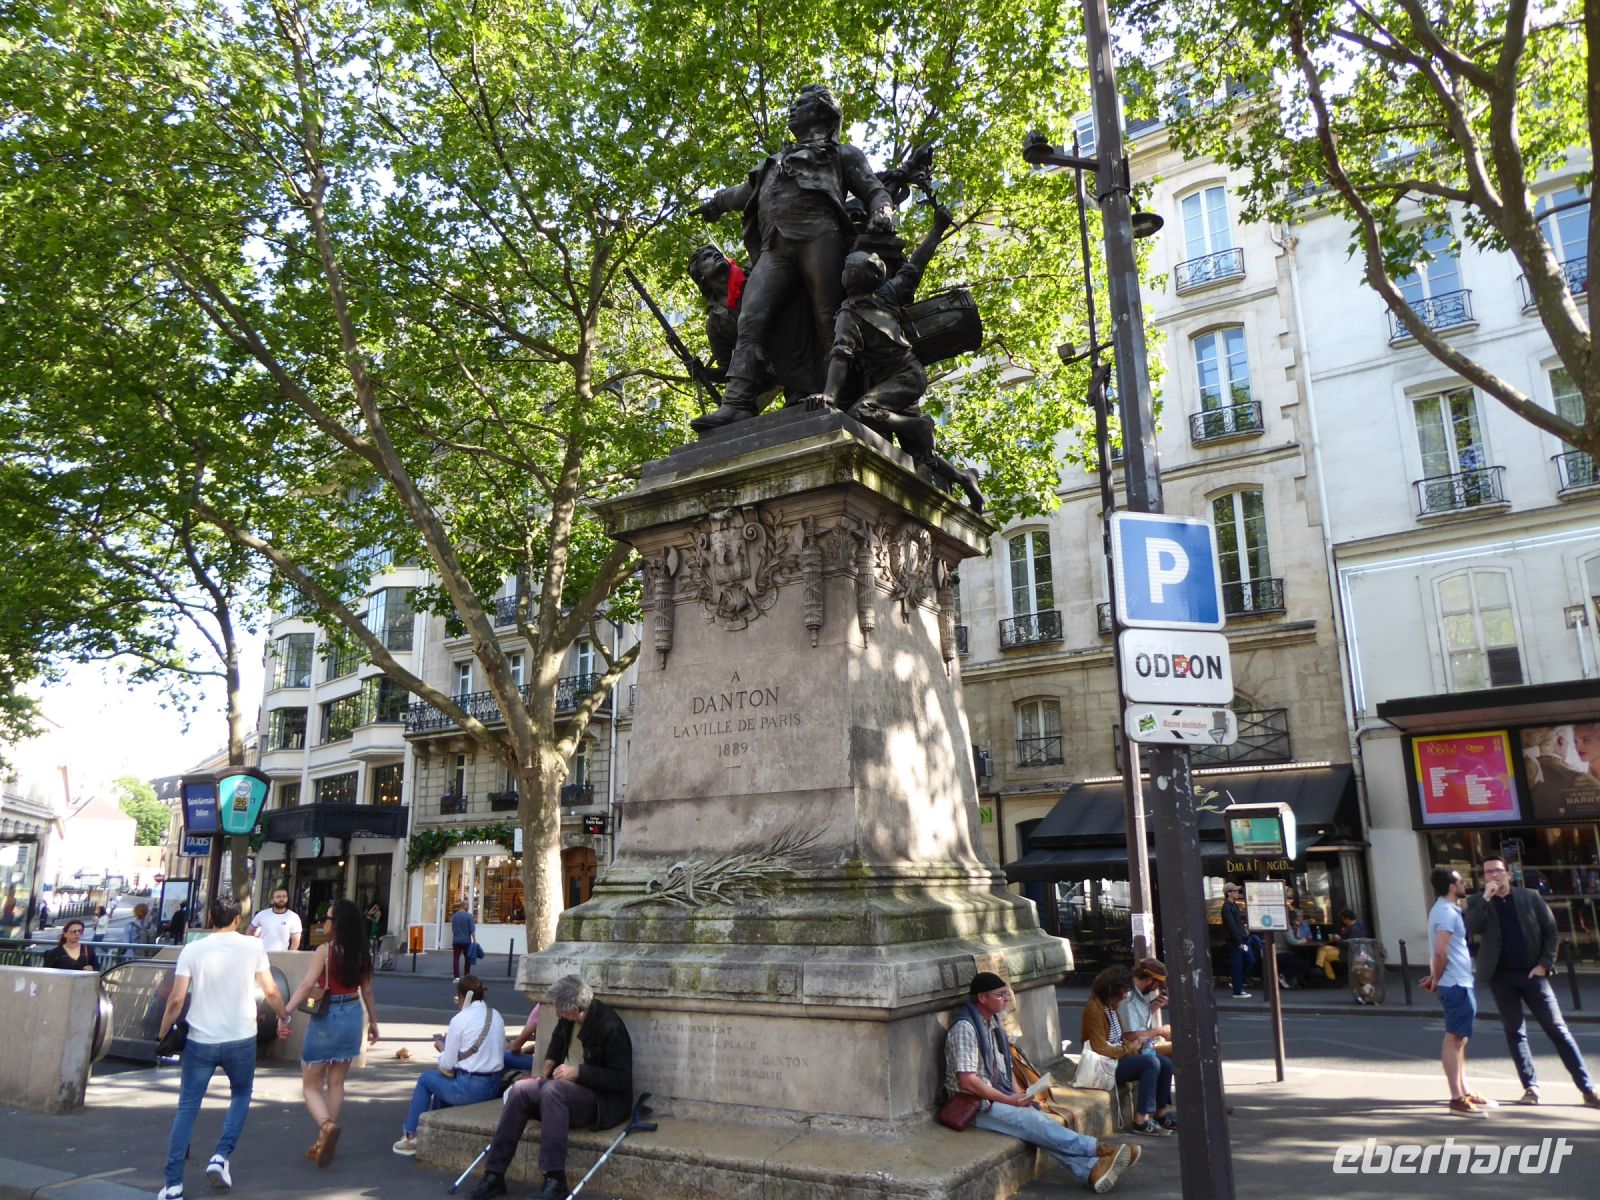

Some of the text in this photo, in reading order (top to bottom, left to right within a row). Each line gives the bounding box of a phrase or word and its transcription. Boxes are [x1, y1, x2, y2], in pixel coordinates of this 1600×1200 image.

[1145, 537, 1190, 604] P
[731, 670, 740, 683] A
[693, 687, 780, 714] DANTON
[672, 712, 801, 738] LA VILLE DE PARIS
[718, 742, 749, 757] 1889
[235, 797, 247, 806] 96
[186, 836, 209, 847] TAXIS
